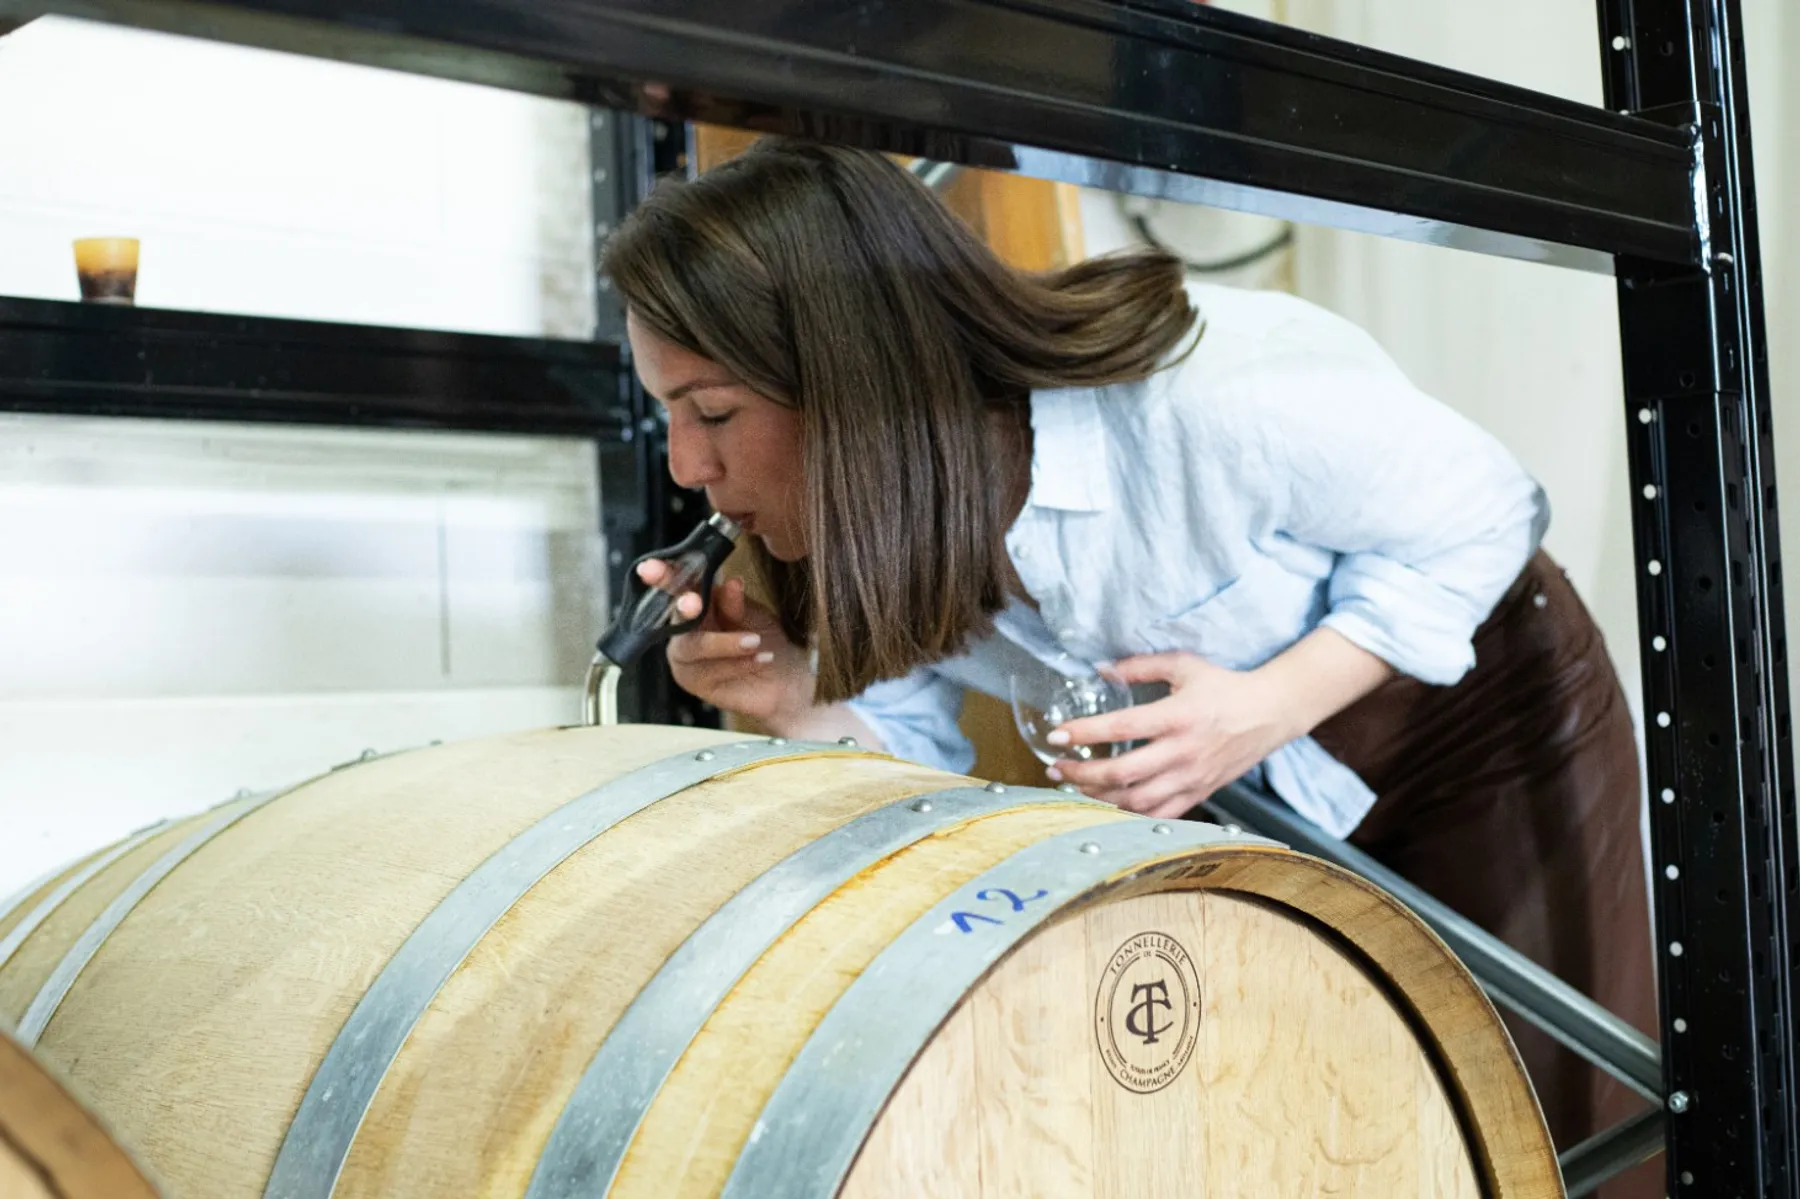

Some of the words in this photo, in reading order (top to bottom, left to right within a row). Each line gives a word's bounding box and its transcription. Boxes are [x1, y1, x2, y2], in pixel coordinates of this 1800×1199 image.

[951, 888, 1048, 933] 12
[1110, 936, 1187, 974] TONNELLERIE
[1120, 1066, 1176, 1088] CHAMPAGNE
